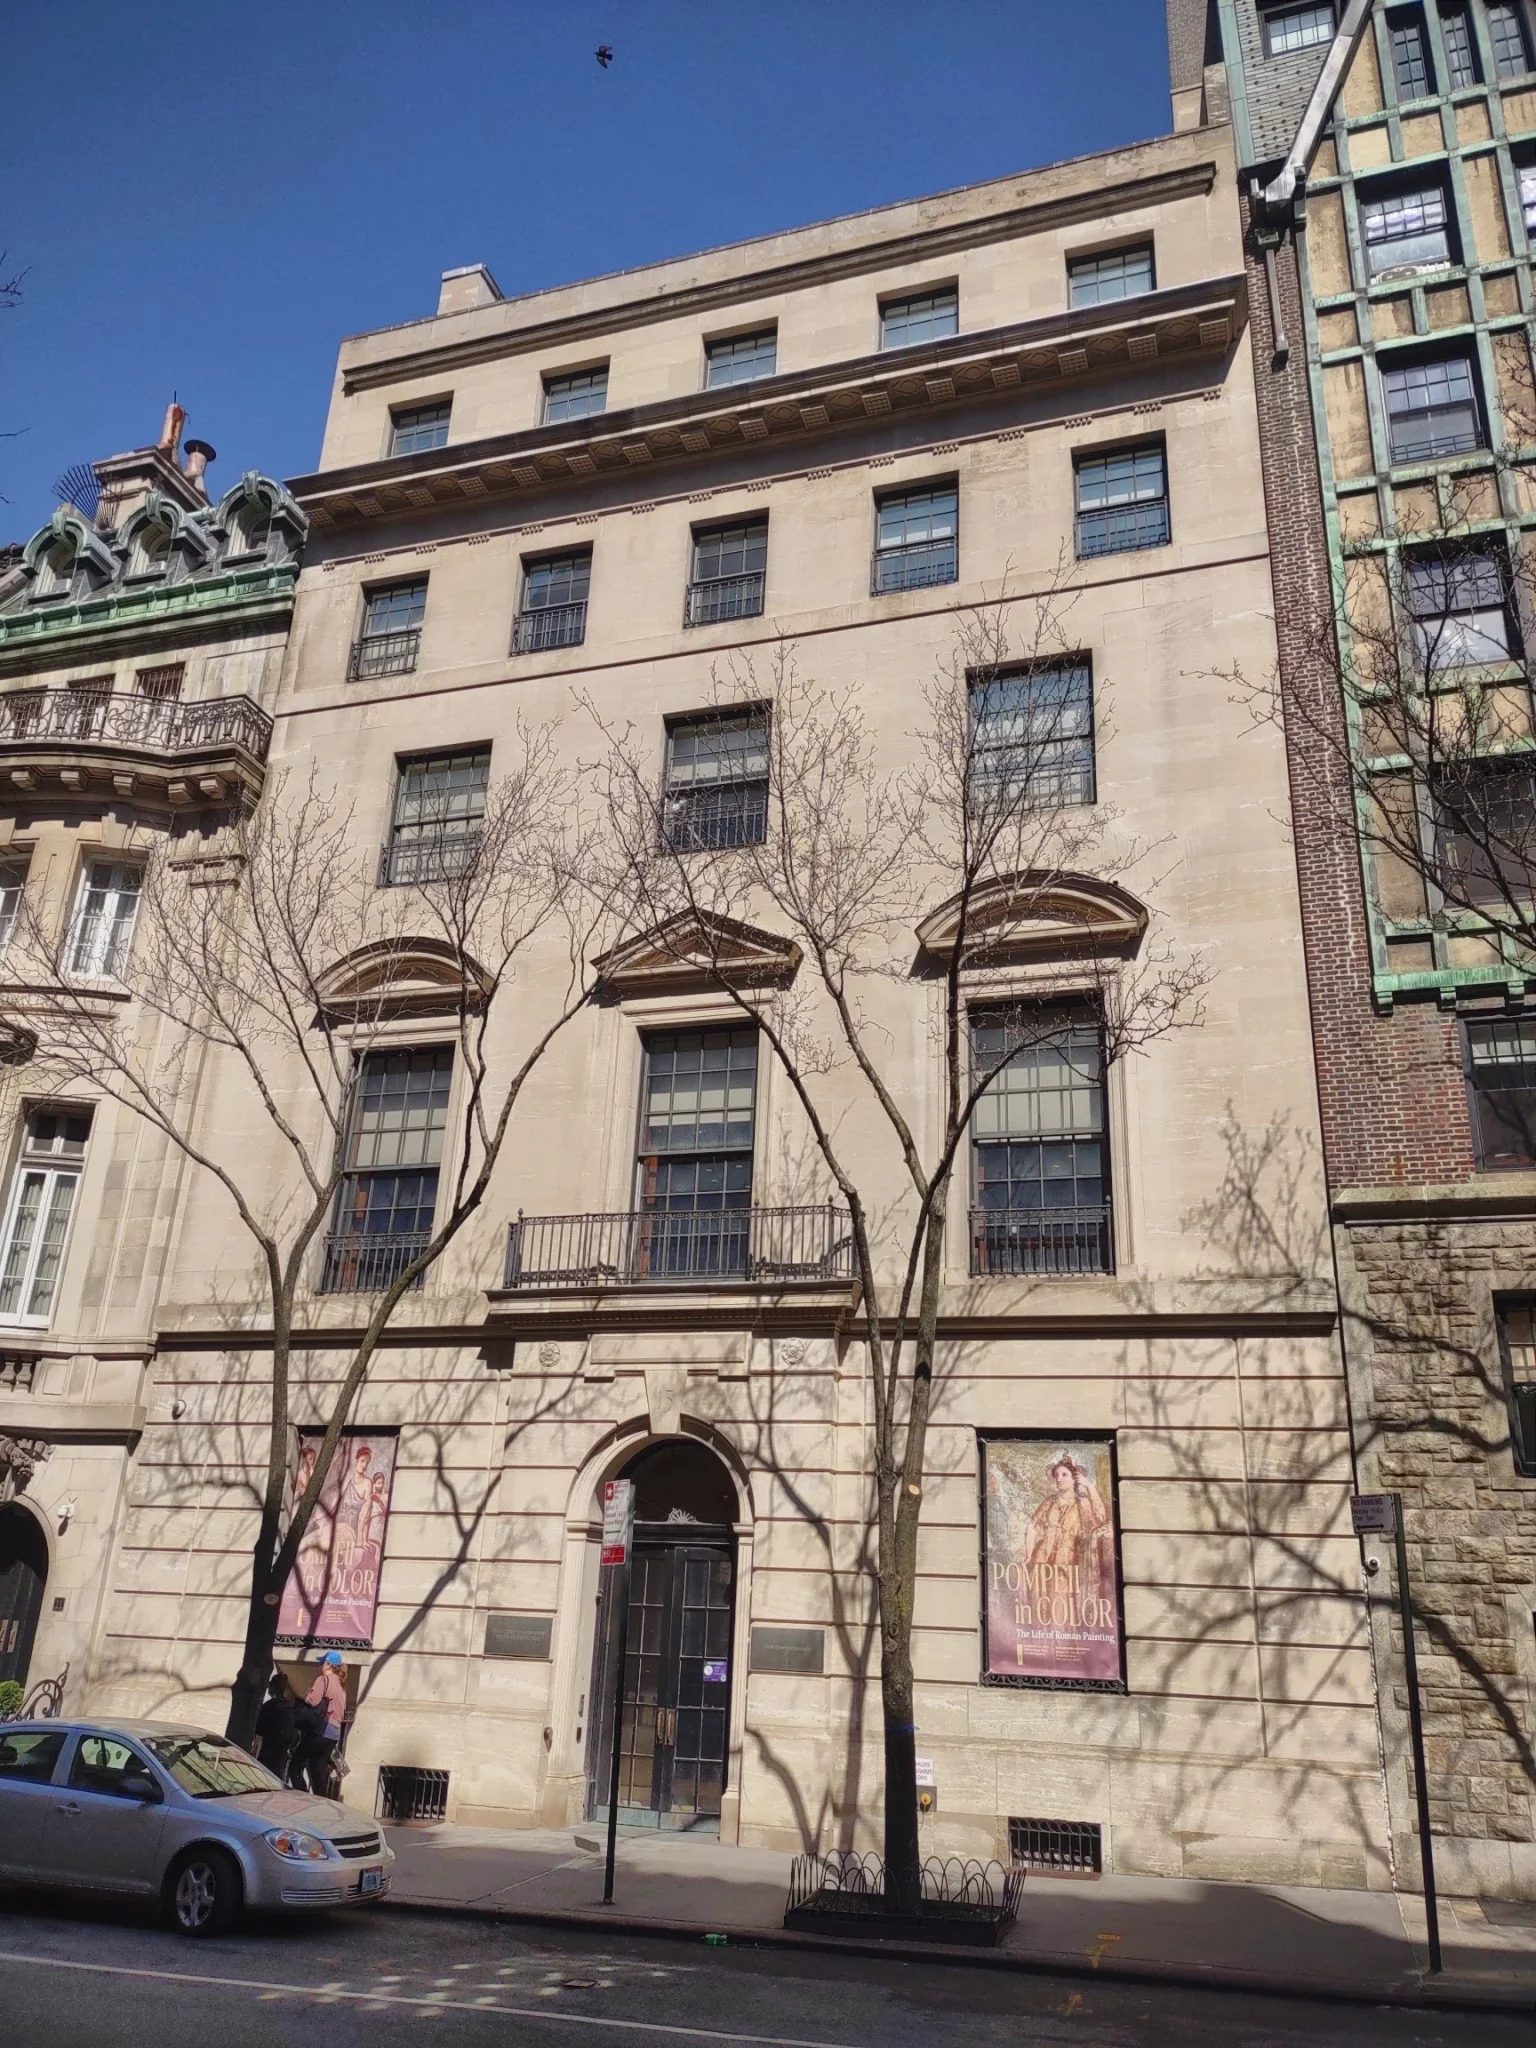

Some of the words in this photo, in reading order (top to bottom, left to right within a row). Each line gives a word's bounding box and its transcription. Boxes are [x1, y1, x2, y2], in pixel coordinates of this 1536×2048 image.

[1361, 1498, 1383, 1506] PARKING
[993, 1562, 1081, 1594] POMPEII
[328, 1597, 348, 1605] Roman
[349, 1597, 373, 1609] Painting
[1015, 1597, 1032, 1624] in
[1036, 1596, 1113, 1628] COLOR
[1016, 1629, 1030, 1638] The
[1031, 1629, 1045, 1639] Life
[1046, 1630, 1055, 1639] of
[1055, 1631, 1081, 1640] Roman
[1083, 1632, 1115, 1644] Painting
